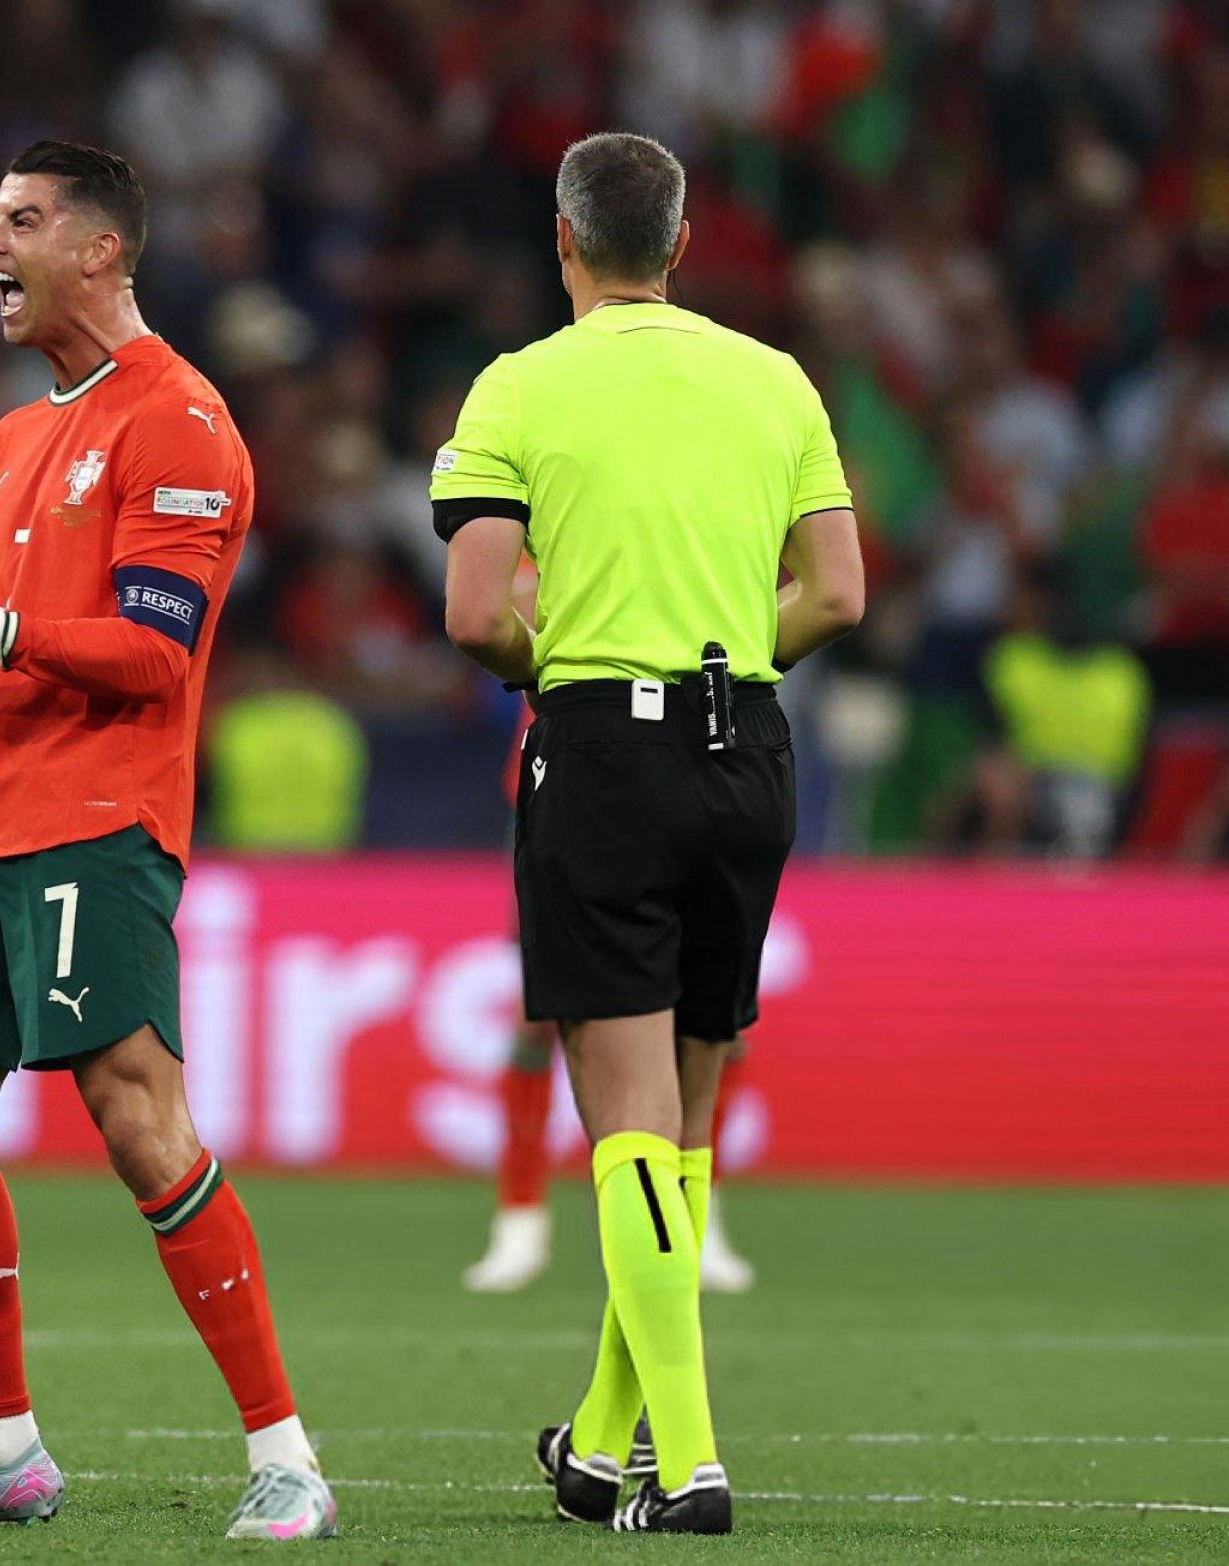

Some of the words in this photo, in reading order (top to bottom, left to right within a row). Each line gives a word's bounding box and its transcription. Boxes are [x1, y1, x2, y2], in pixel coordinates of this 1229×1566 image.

[206, 497, 220, 511] 10
[142, 591, 193, 620] RESPECT
[44, 882, 79, 979] 7
